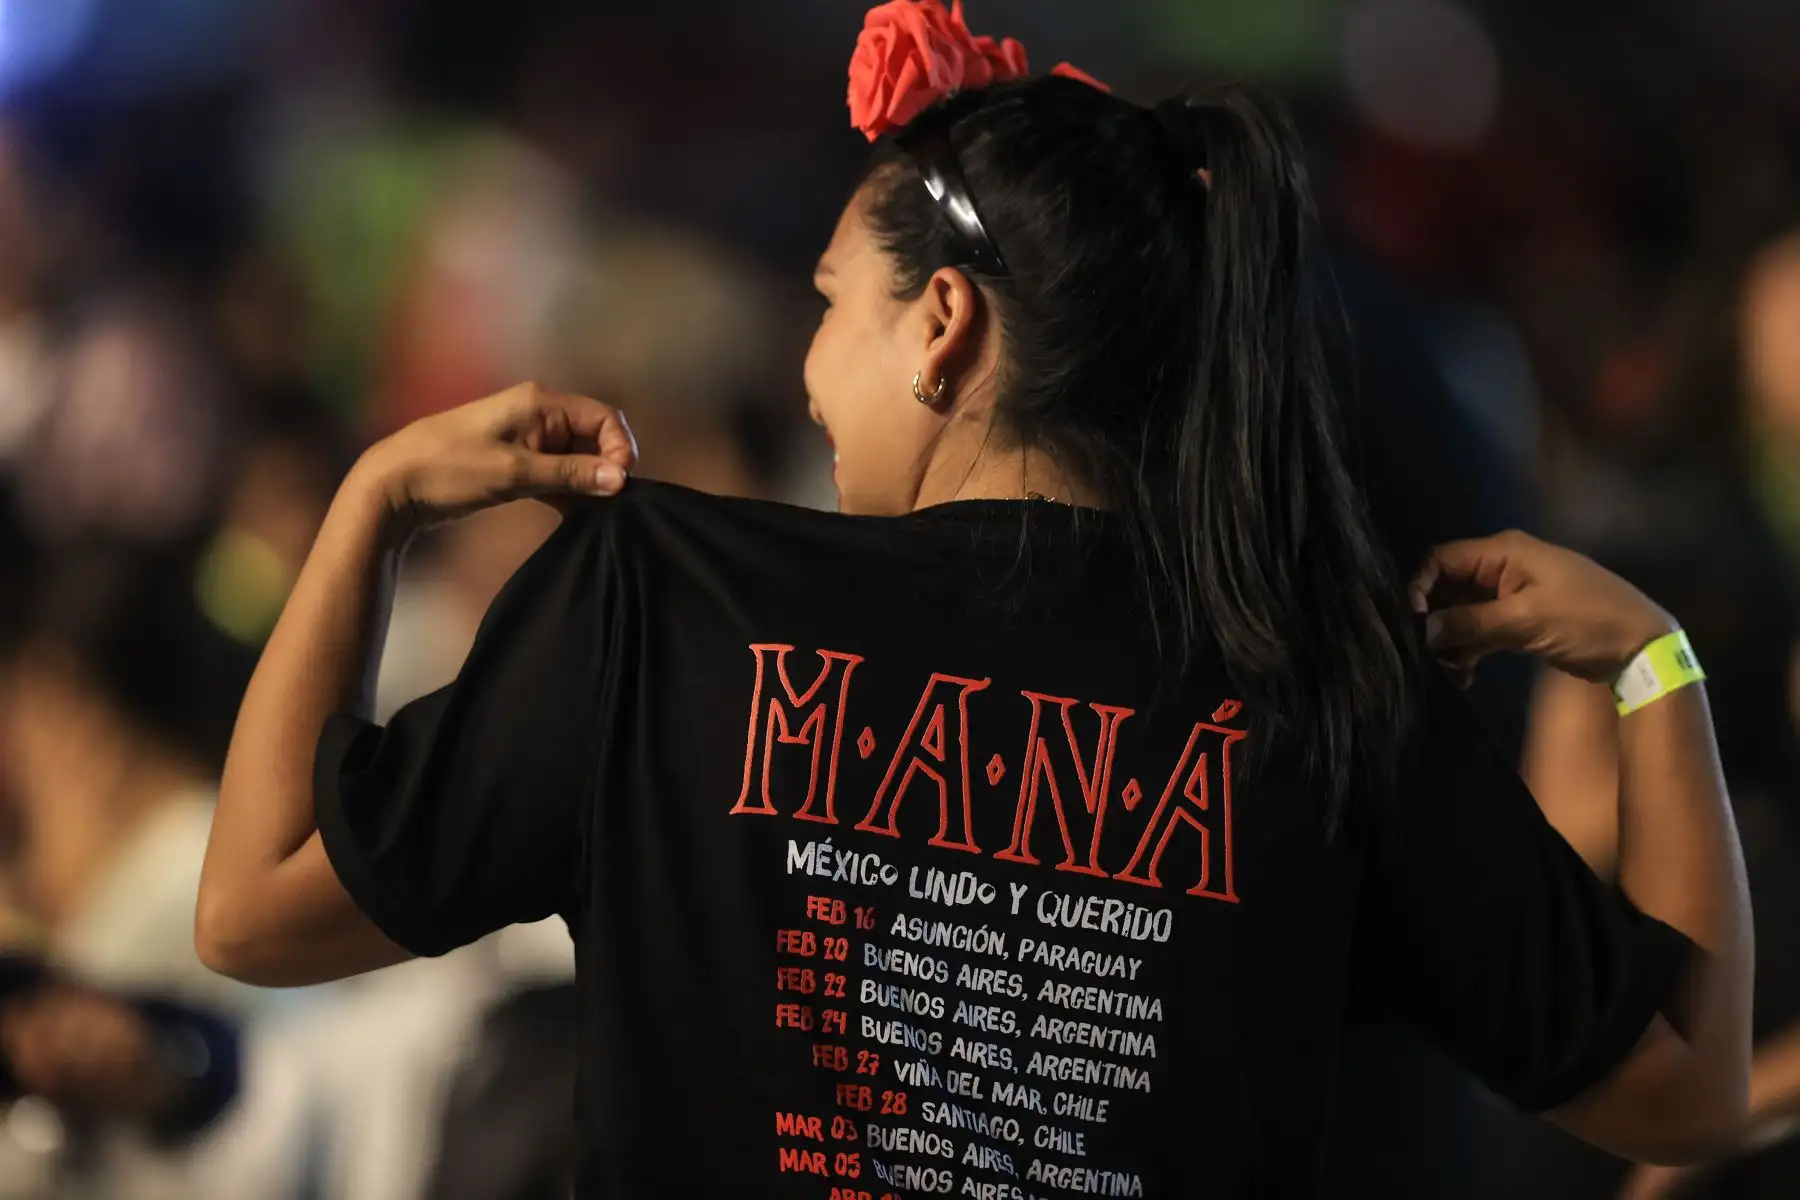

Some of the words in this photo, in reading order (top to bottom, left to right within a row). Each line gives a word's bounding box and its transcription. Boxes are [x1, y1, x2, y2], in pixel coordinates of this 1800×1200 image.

[806, 895, 846, 925] FEB
[853, 906, 876, 930] 16
[890, 913, 1009, 960] ASUNCIÓN,
[1018, 937, 1142, 981] PARAGUAY
[1009, 882, 1028, 915] Y
[776, 929, 817, 957] FEB
[823, 937, 849, 962] 20
[864, 942, 949, 984] BUENOS
[955, 963, 1028, 1001] AIRES,
[1037, 979, 1163, 1022] ARGENTINA
[776, 967, 817, 995] FEB
[824, 972, 847, 998] 22
[860, 979, 945, 1019] BUENOS
[952, 1000, 1022, 1038] AIRES,
[1030, 1014, 1157, 1058] ARGENTINA
[776, 1003, 815, 1032] FEB
[821, 1008, 848, 1035] 24
[861, 1015, 943, 1056] BUENOS
[950, 1036, 1019, 1074] AIRES,
[1025, 1051, 1151, 1094] ARGENTINA
[812, 1043, 849, 1072] FEB
[893, 1058, 943, 1089] VIÑA
[947, 1070, 984, 1100] DEL
[991, 1081, 1048, 1115] MAR,
[1053, 1091, 1110, 1123] CHILE
[775, 1111, 824, 1142] MAR
[830, 1115, 859, 1141] 03
[866, 1123, 954, 1159] BUENOS
[961, 1142, 1020, 1181] AIRES,
[1026, 1158, 1144, 1198] ARGENTINA
[836, 1083, 872, 1112] FEB
[880, 1090, 908, 1116] 28
[921, 1101, 1025, 1146] SANTIAGO,
[1034, 1125, 1087, 1156] CHILE
[779, 1147, 829, 1178] MAR
[834, 1152, 861, 1179] 05
[872, 1158, 953, 1194] BUENOS
